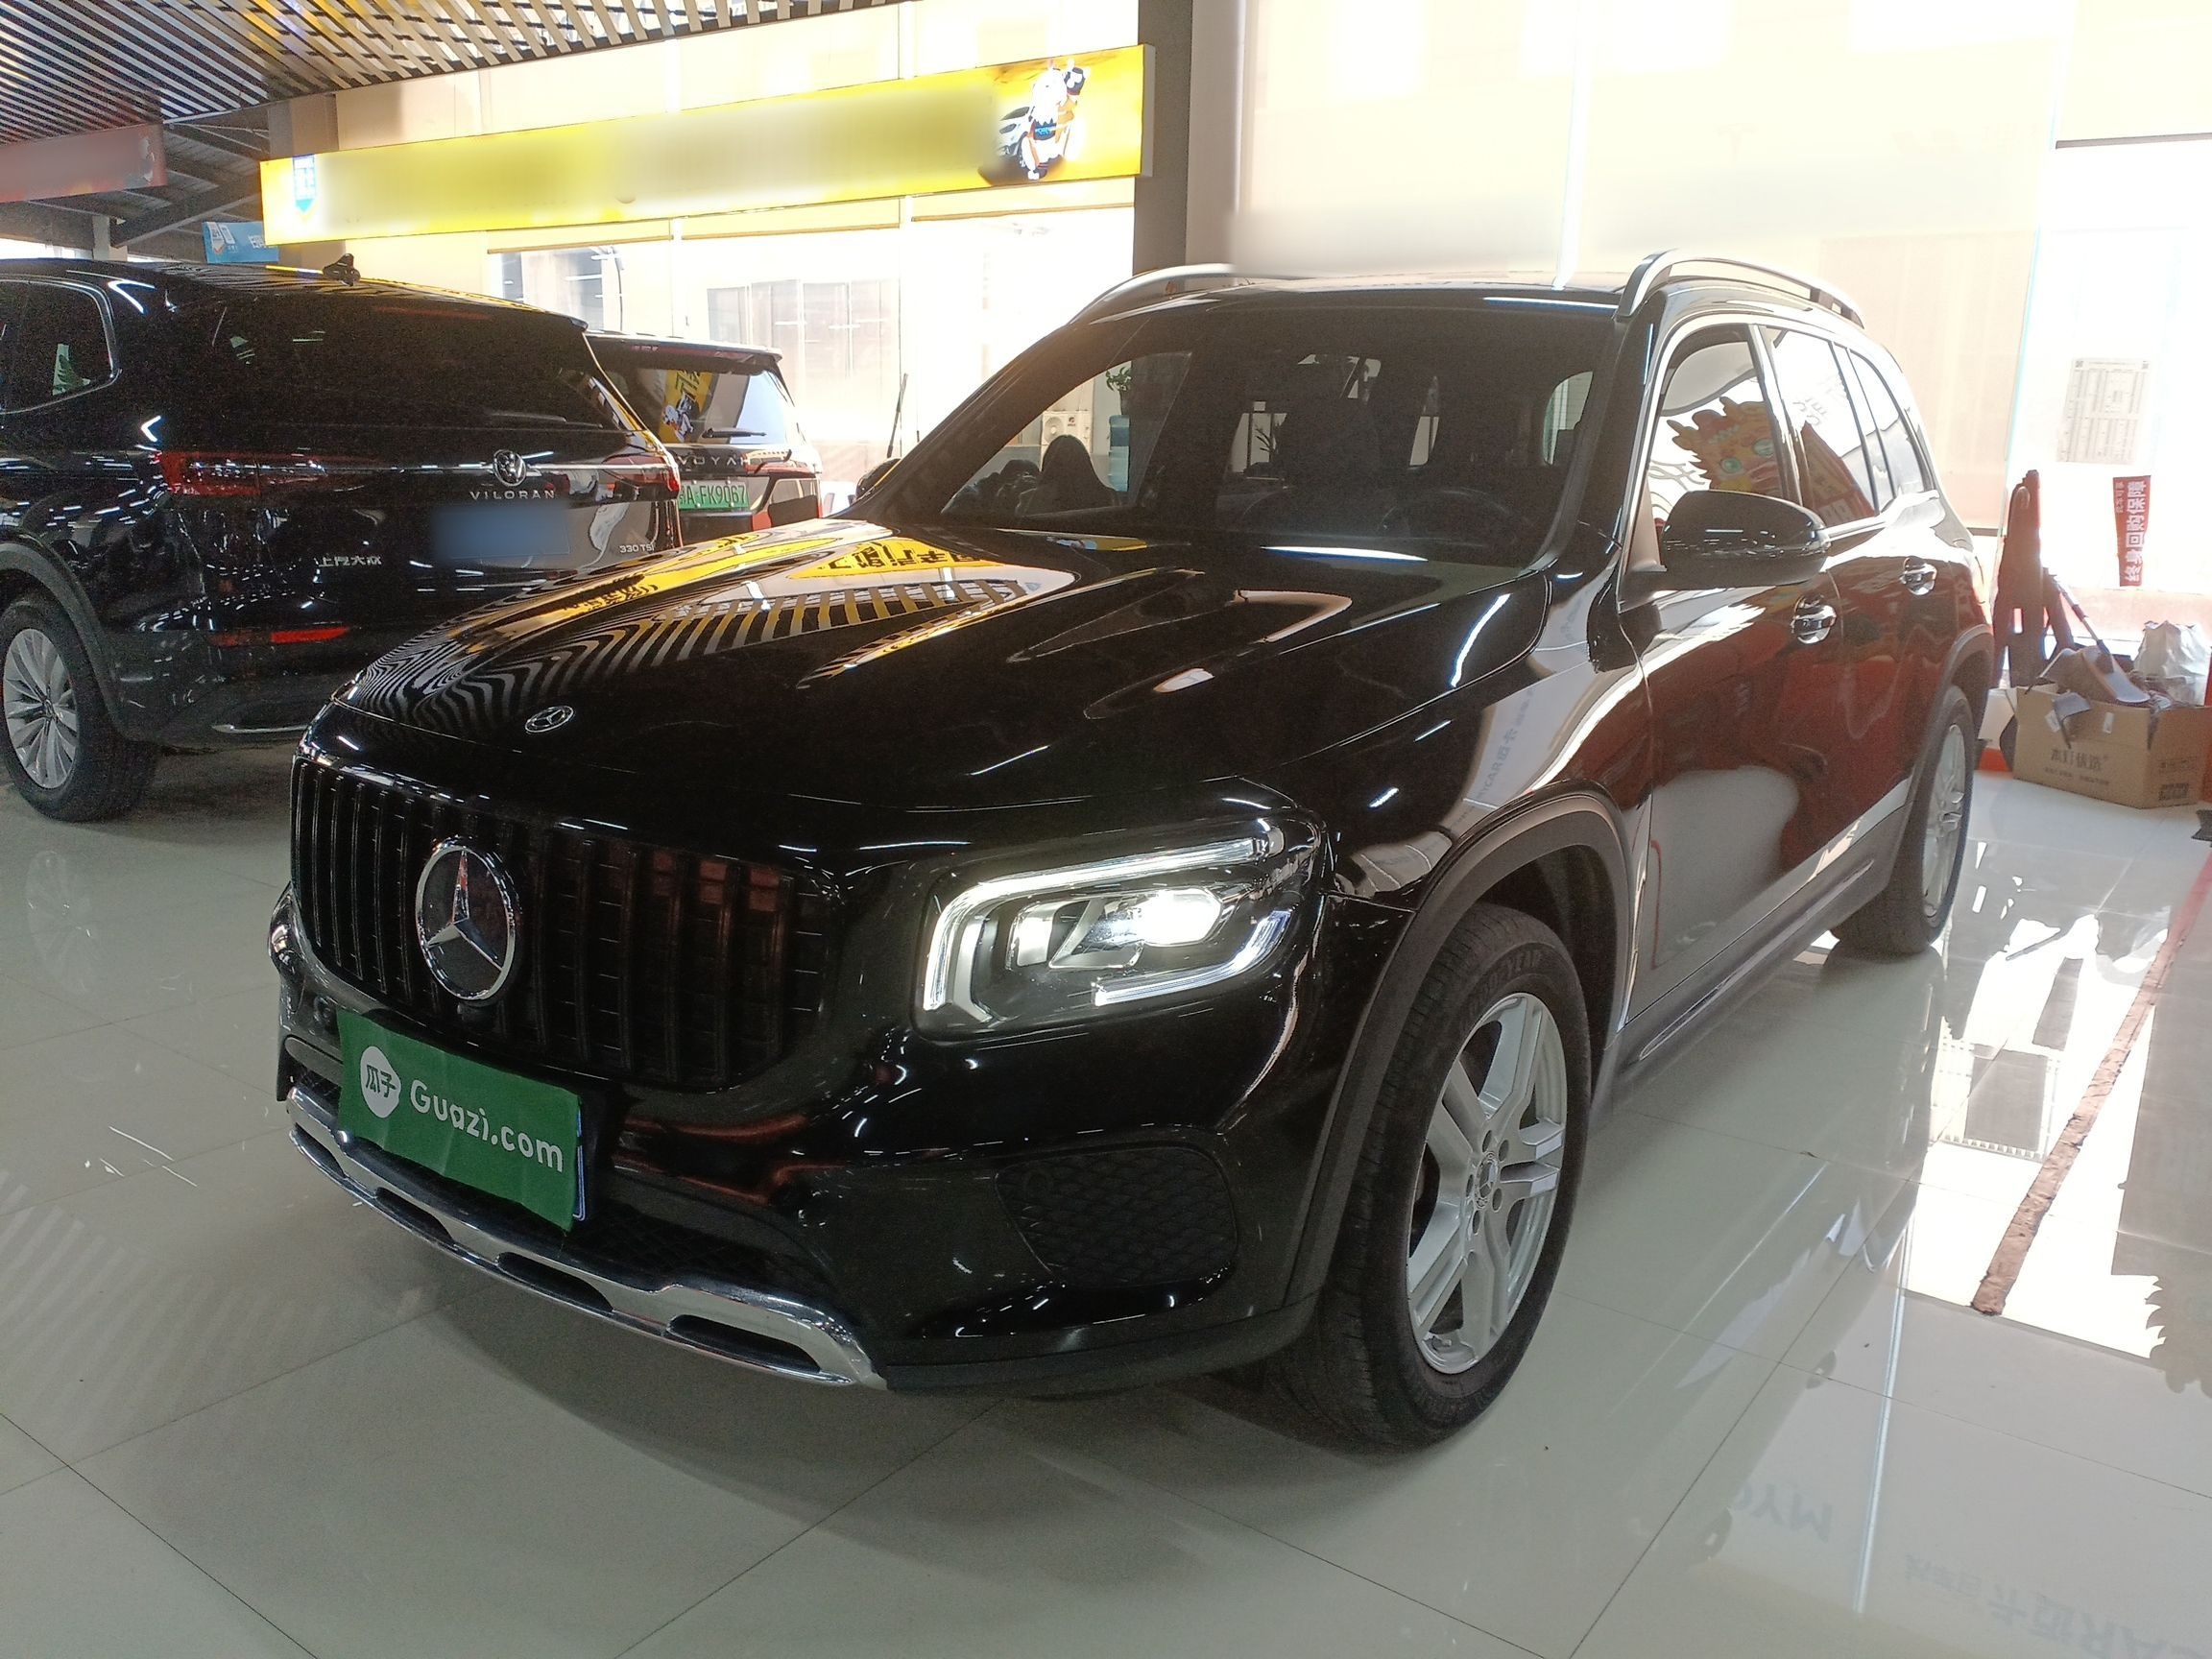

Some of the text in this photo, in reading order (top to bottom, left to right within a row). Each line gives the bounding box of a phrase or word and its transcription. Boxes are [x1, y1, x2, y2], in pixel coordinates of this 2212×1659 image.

[469, 490, 556, 500] VILORAN
[618, 544, 639, 554] 330
[2124, 480, 2147, 583] 终身回购保障
[365, 1064, 397, 1099] 瓜子
[410, 1079, 565, 1173] Guazi.com
